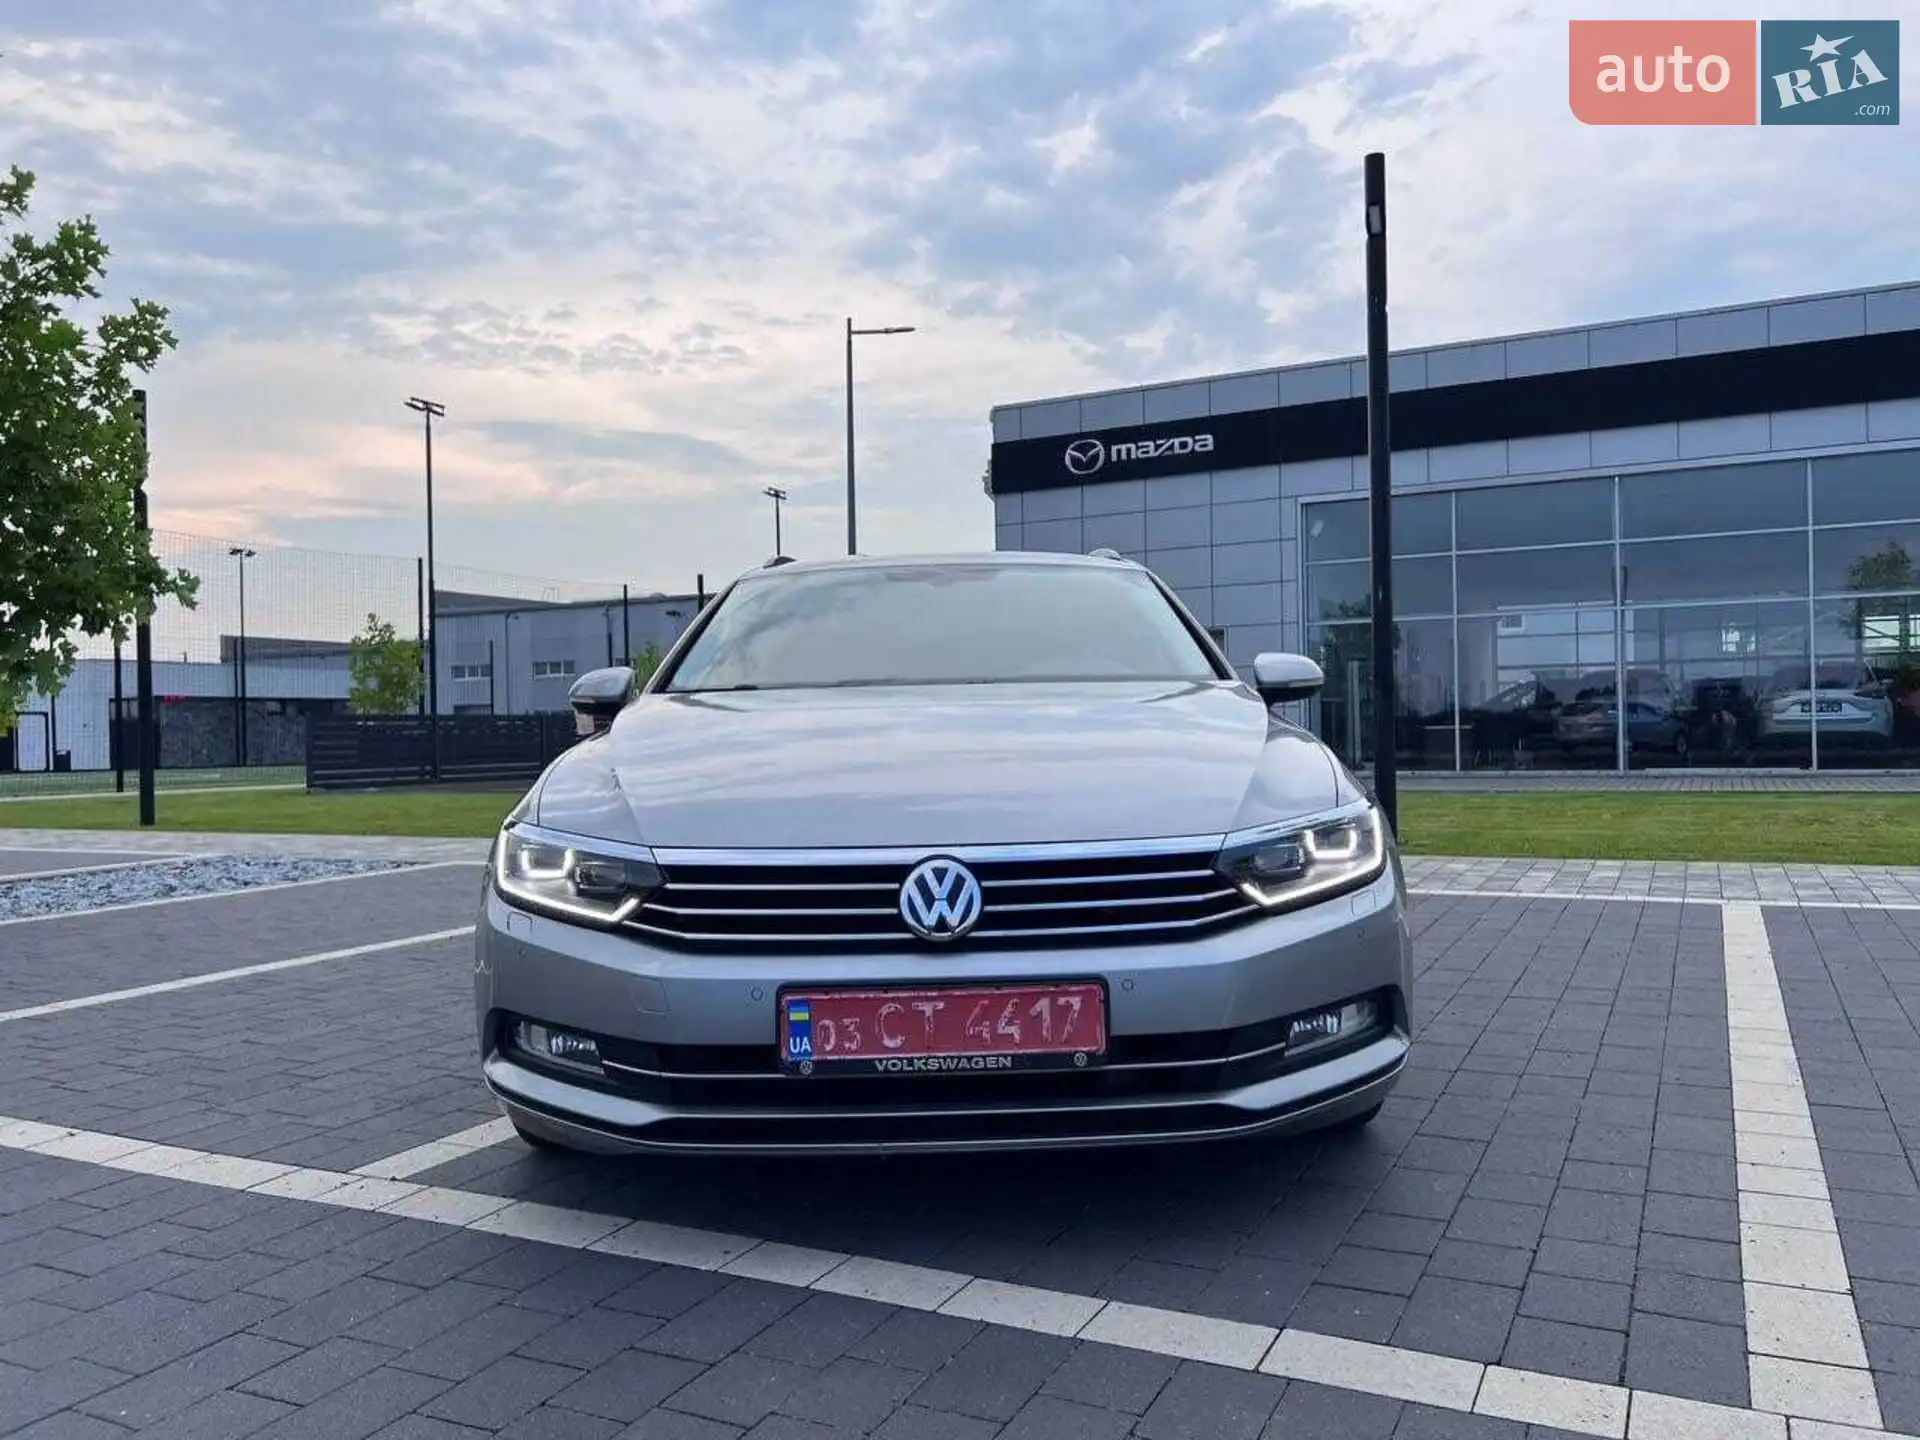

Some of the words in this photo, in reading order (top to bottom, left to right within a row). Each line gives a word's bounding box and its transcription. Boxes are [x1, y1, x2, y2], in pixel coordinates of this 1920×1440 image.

[1110, 434, 1214, 462] mazda
[789, 1036, 812, 1054] UA
[816, 1017, 861, 1052] 03
[875, 1001, 945, 1049] CT
[963, 995, 1082, 1045] 4417
[874, 1055, 1012, 1073] VOLKSWAGEN
